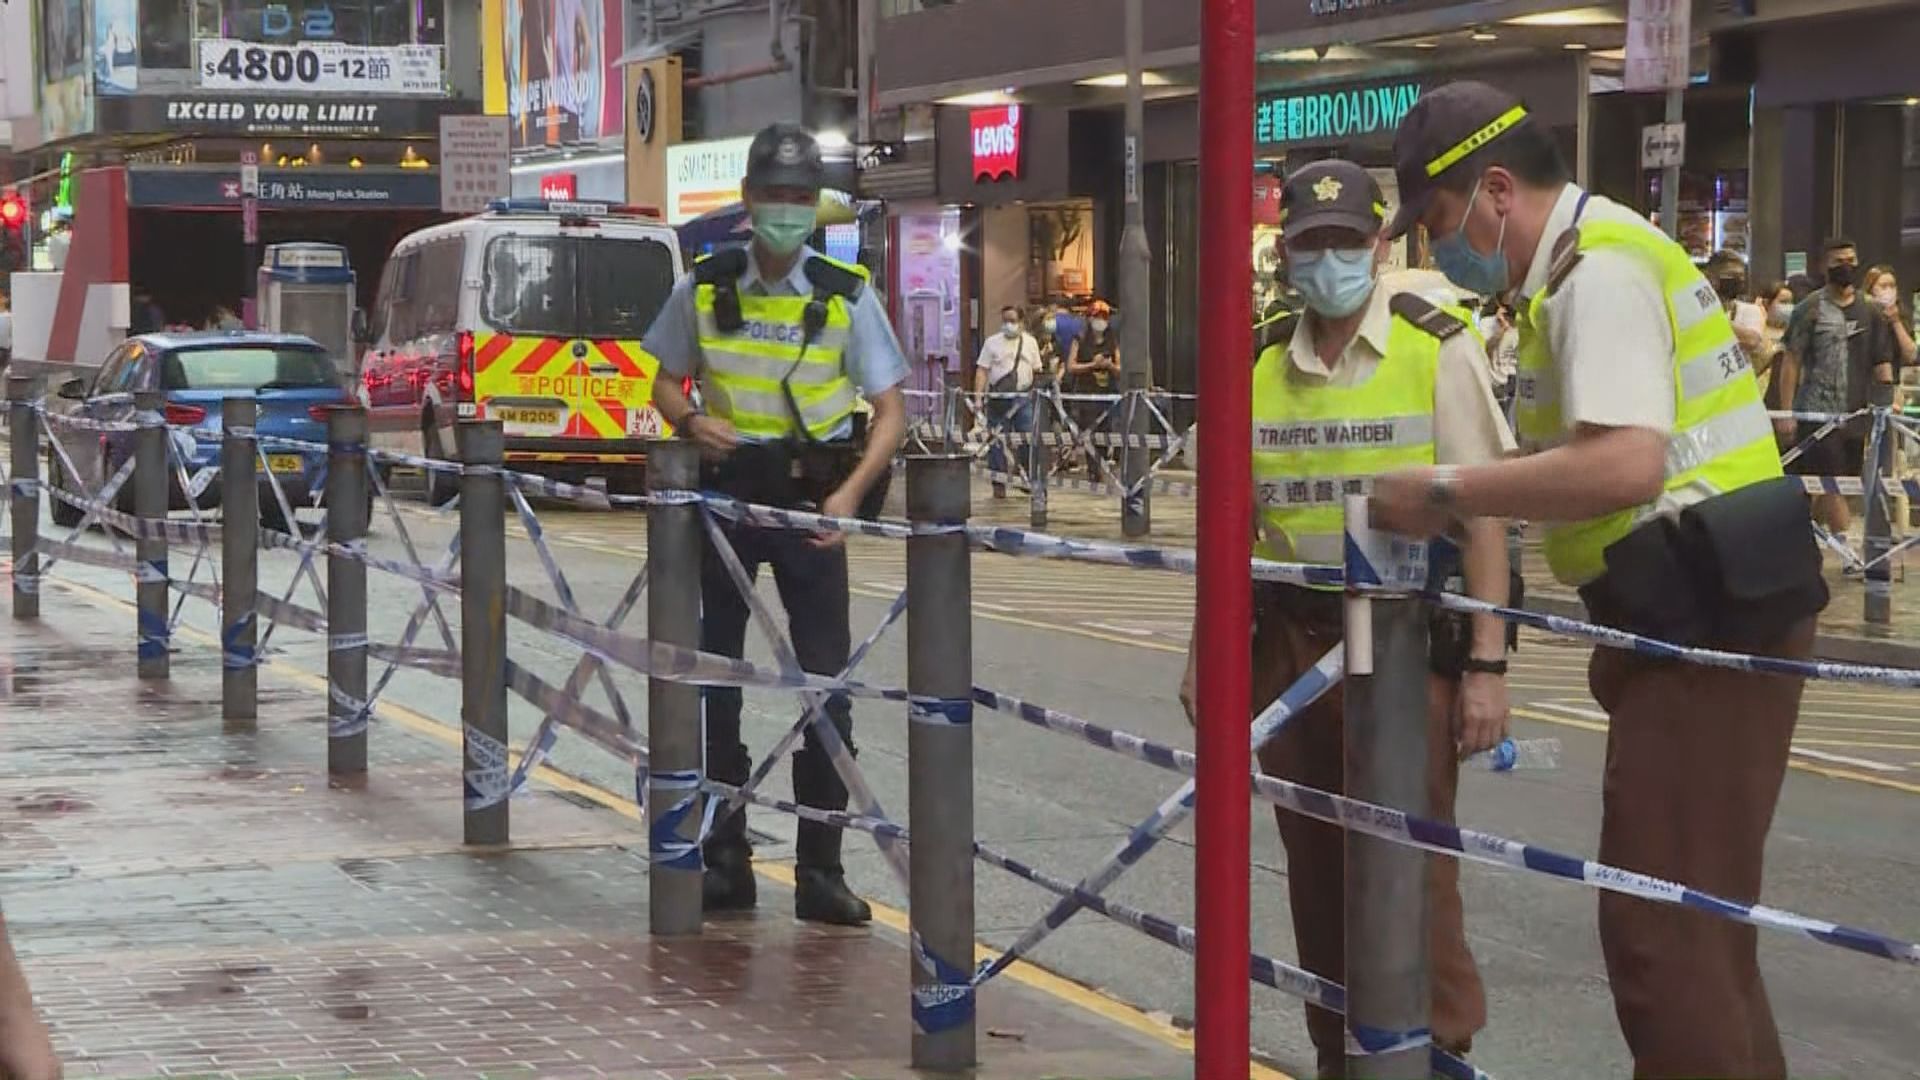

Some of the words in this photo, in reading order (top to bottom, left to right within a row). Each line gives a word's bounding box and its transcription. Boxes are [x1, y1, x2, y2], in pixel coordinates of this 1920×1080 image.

[167, 102, 245, 119] EXCEED
[253, 103, 310, 121] YOUR
[317, 104, 378, 121] LIMIT
[307, 190, 336, 201] Mong
[337, 190, 354, 199] Kok
[355, 189, 389, 200] Station
[538, 377, 616, 397] POLICE
[521, 411, 557, 423] 8205
[634, 410, 656, 423] MK
[1259, 428, 1318, 446] TRAFFIC
[1323, 424, 1394, 444] WARDEN
